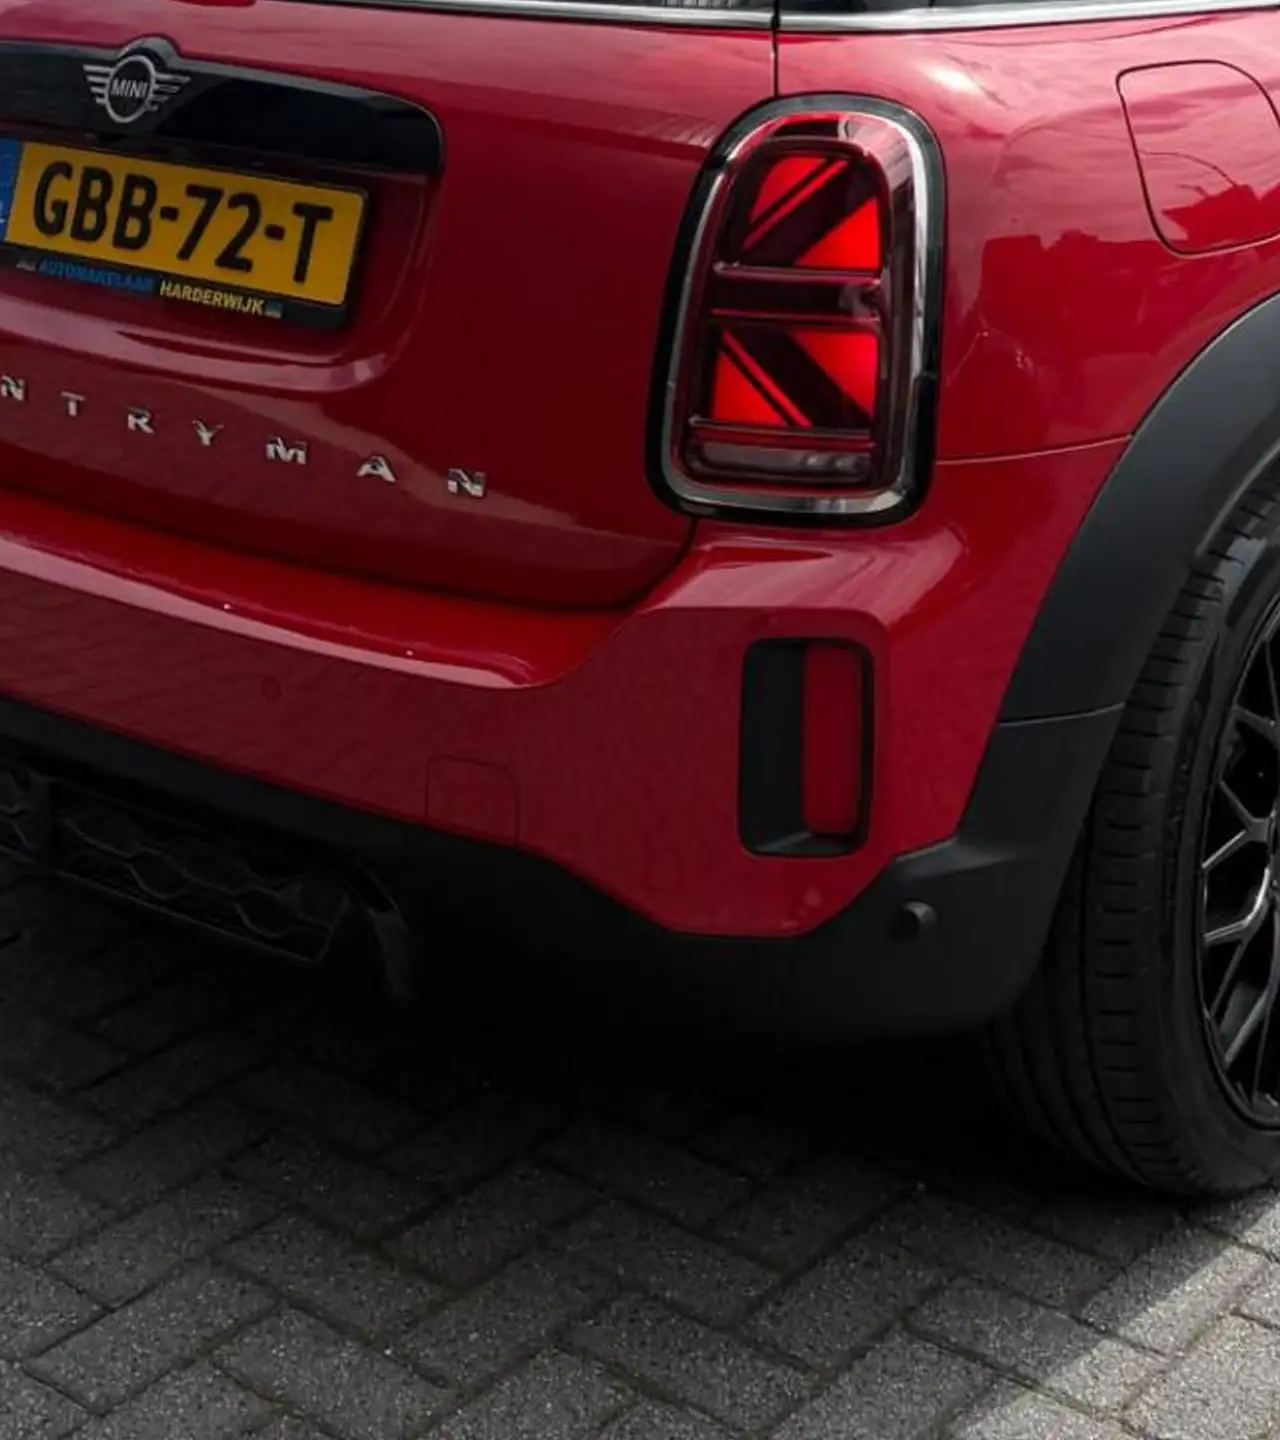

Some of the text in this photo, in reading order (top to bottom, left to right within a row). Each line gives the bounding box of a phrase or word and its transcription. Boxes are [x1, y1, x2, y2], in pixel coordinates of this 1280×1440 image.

[110, 78, 148, 98] MINI
[32, 160, 334, 284] GBB-72-T
[159, 279, 266, 317] HARDERWIJK
